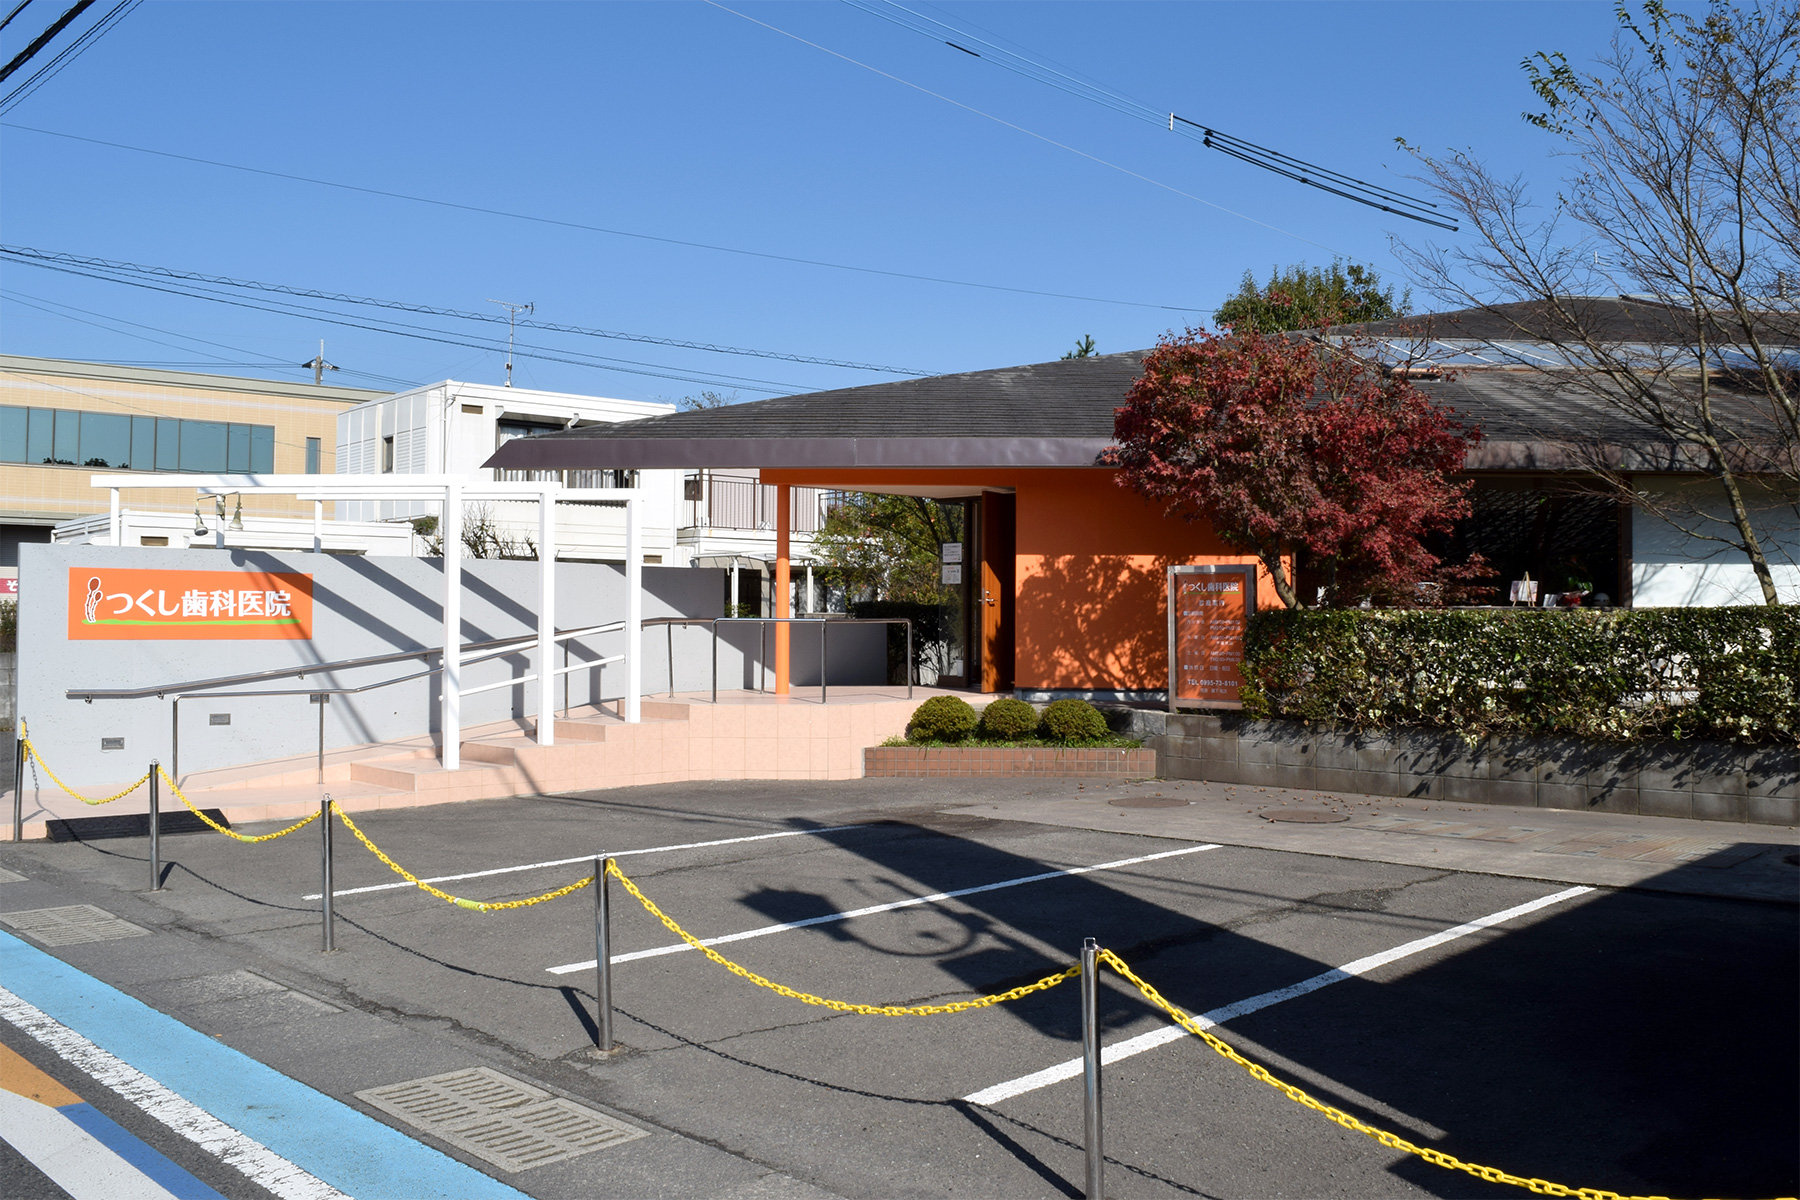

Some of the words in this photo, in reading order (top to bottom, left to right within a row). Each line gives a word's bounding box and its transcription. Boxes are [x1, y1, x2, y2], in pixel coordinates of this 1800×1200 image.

[1188, 582, 1239, 592] つくし歯科医院
[106, 588, 292, 617] つくし歯科医院
[1187, 678, 1200, 686] TEL
